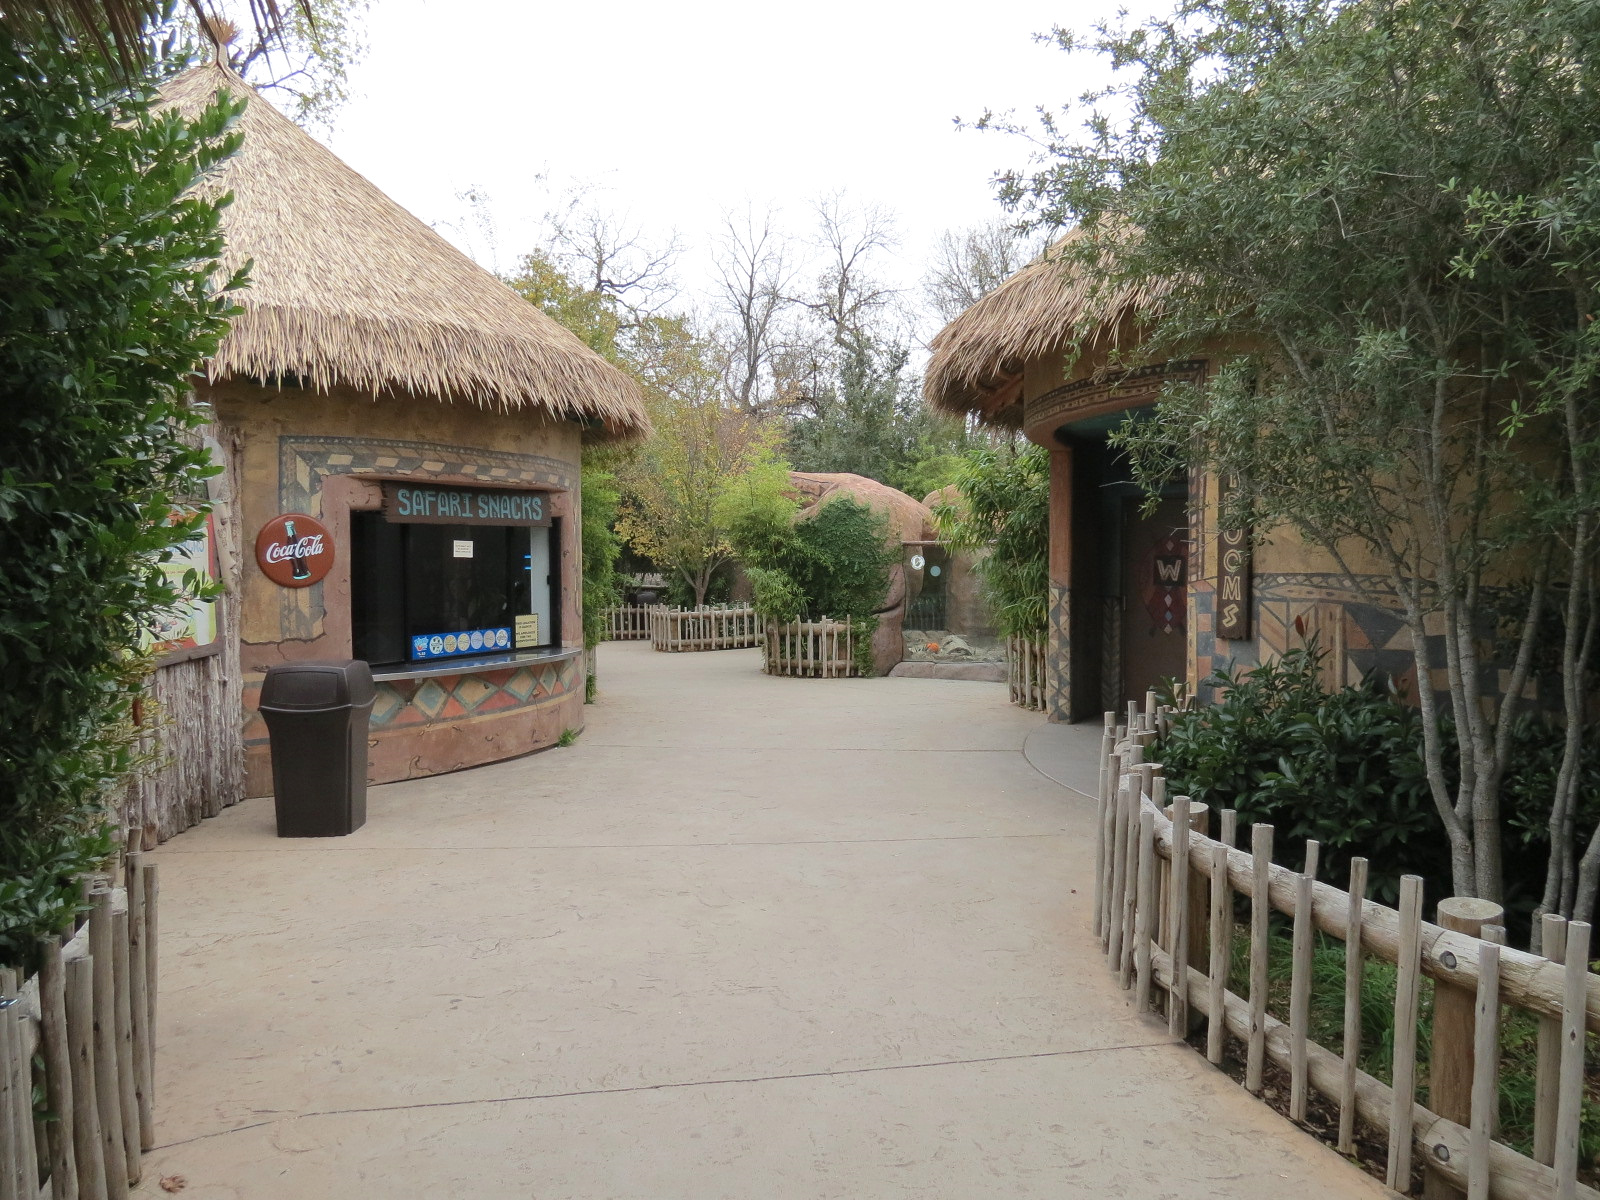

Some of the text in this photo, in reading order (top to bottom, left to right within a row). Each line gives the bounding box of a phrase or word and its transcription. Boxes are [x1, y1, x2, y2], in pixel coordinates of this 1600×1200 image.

[397, 488, 543, 521] SAFARI SNACKS
[266, 534, 324, 564] Coca-Cola
[1156, 559, 1182, 582] W
